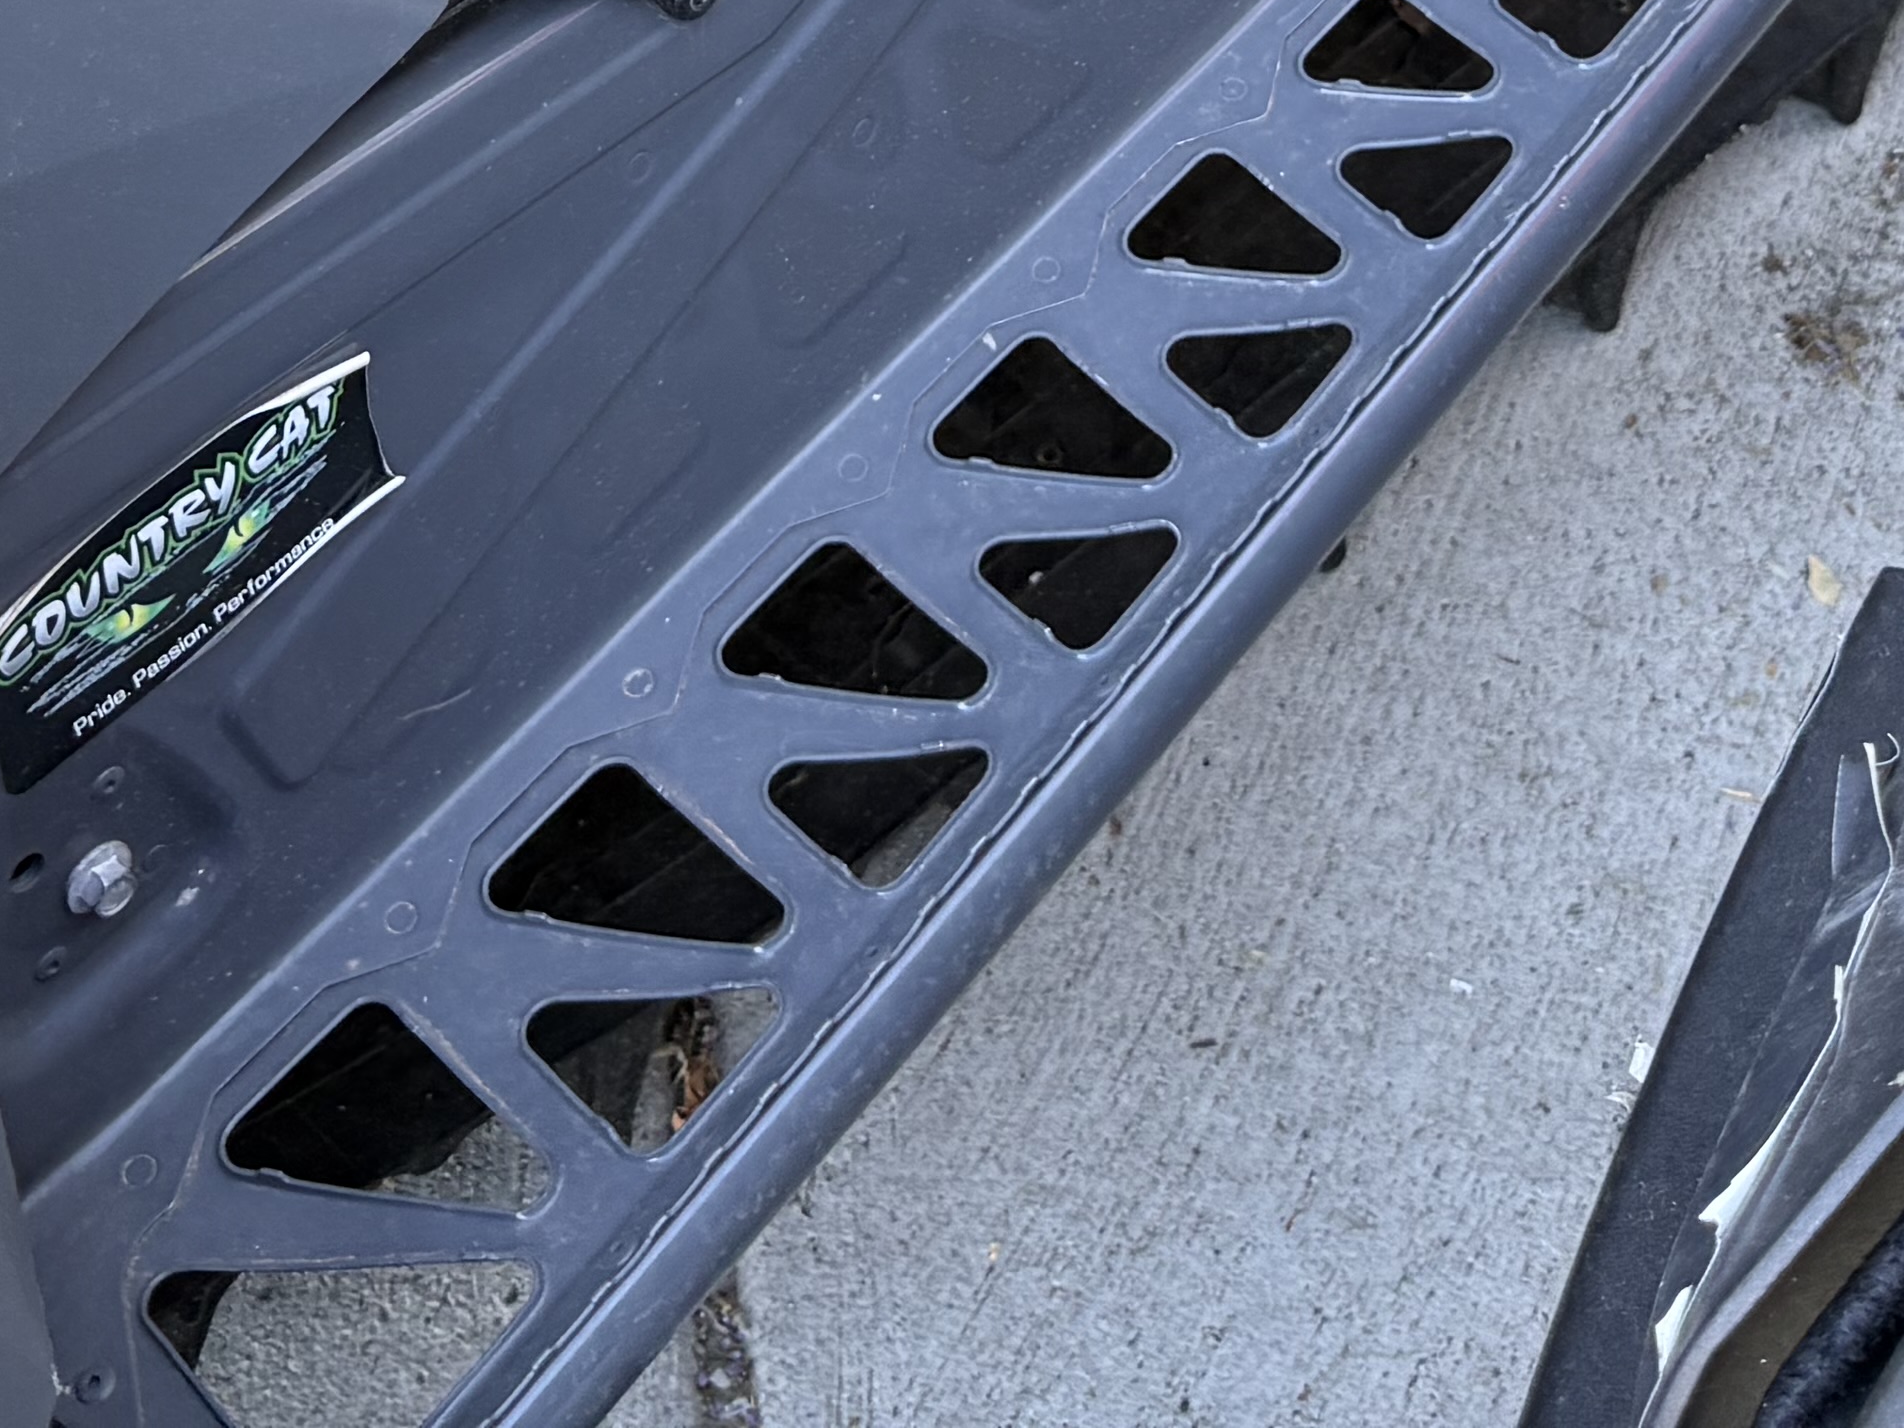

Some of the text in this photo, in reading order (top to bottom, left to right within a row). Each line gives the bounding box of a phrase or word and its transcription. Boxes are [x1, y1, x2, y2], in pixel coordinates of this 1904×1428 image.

[246, 384, 338, 479] CAT
[72, 516, 336, 737] Pride. Passion. Performance
